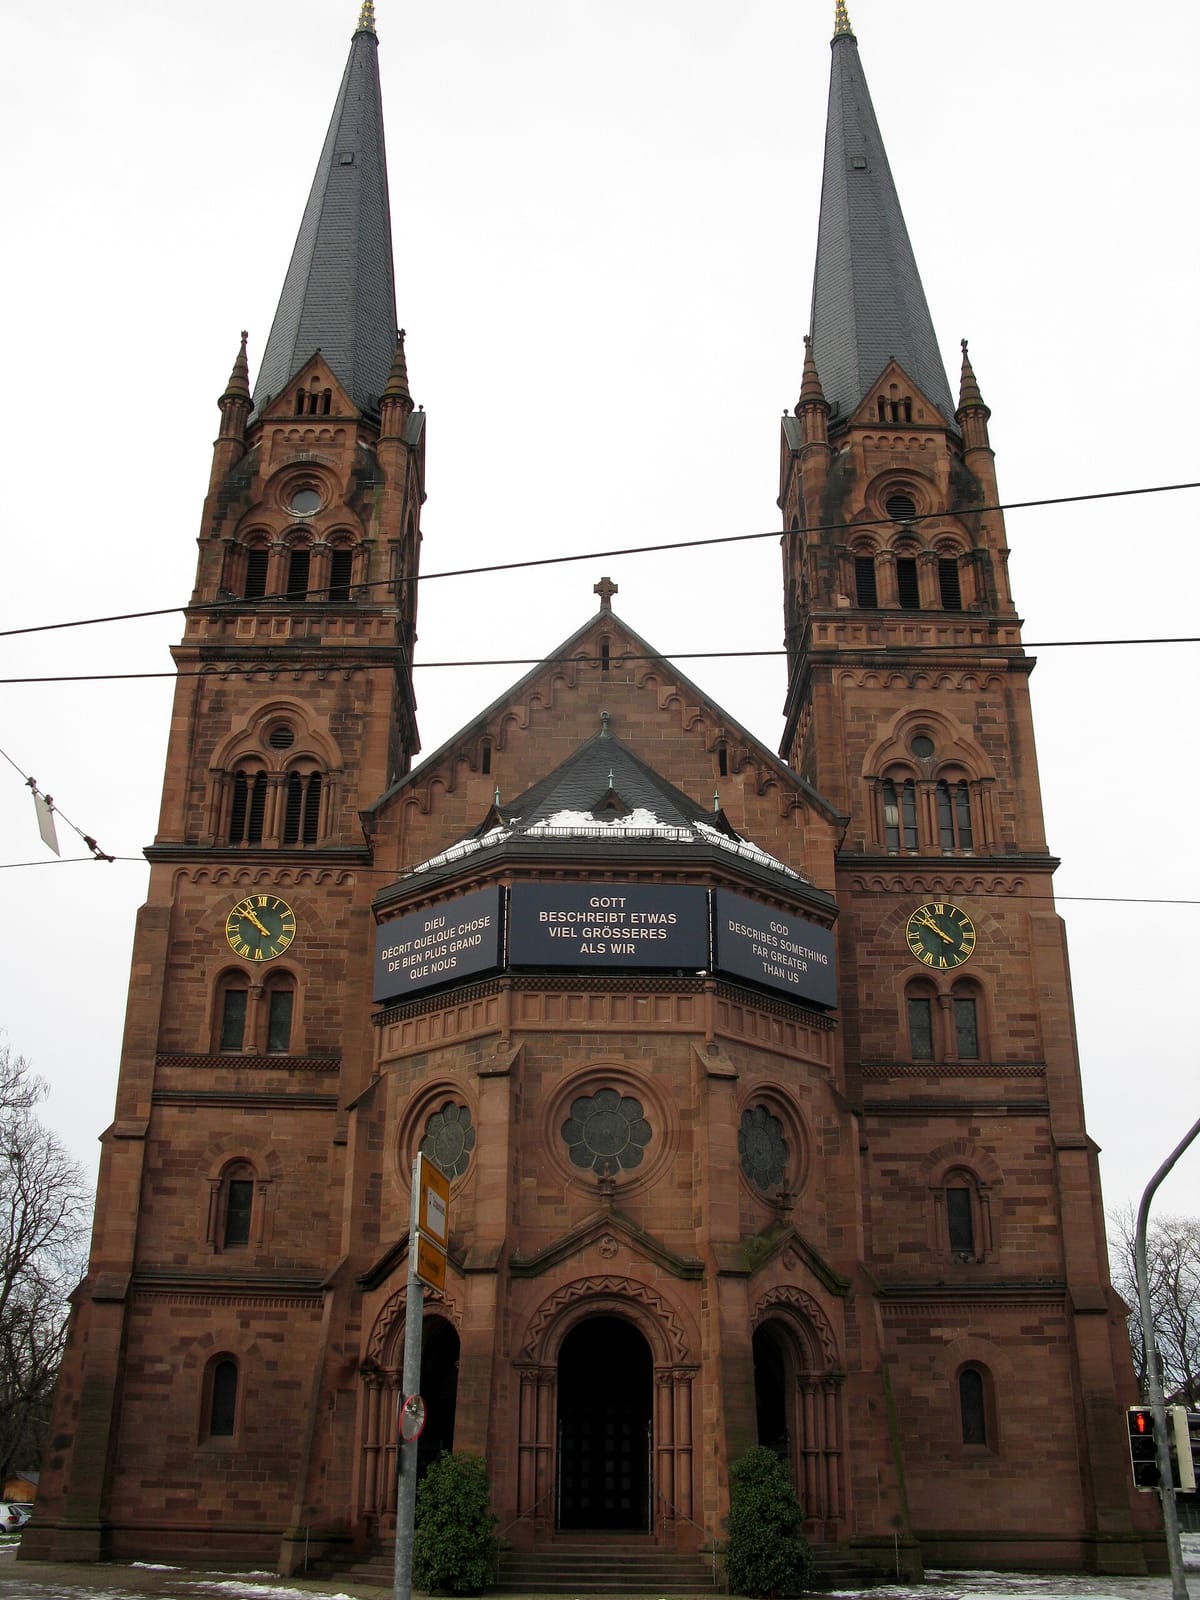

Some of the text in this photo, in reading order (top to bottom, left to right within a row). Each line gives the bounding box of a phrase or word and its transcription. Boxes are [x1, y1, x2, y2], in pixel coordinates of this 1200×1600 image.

[590, 898, 626, 907] GOTT
[424, 917, 445, 932] DIEU
[540, 912, 677, 924] BESCHREIBT ETWAS
[414, 928, 455, 948] QUELQUE
[459, 916, 490, 934] CHOSE
[549, 926, 667, 938] VIEL GRÖSSERES
[770, 922, 788, 935] GOD
[580, 944, 635, 954] ALS WIR
[729, 921, 828, 964] DESCRIBES SOMETHING
[389, 935, 481, 972] DE BIEN PLUS GRAND
[752, 944, 807, 972] FAR GREATER
[410, 957, 456, 979] QUE NOUS
[762, 962, 799, 983] THAN US
